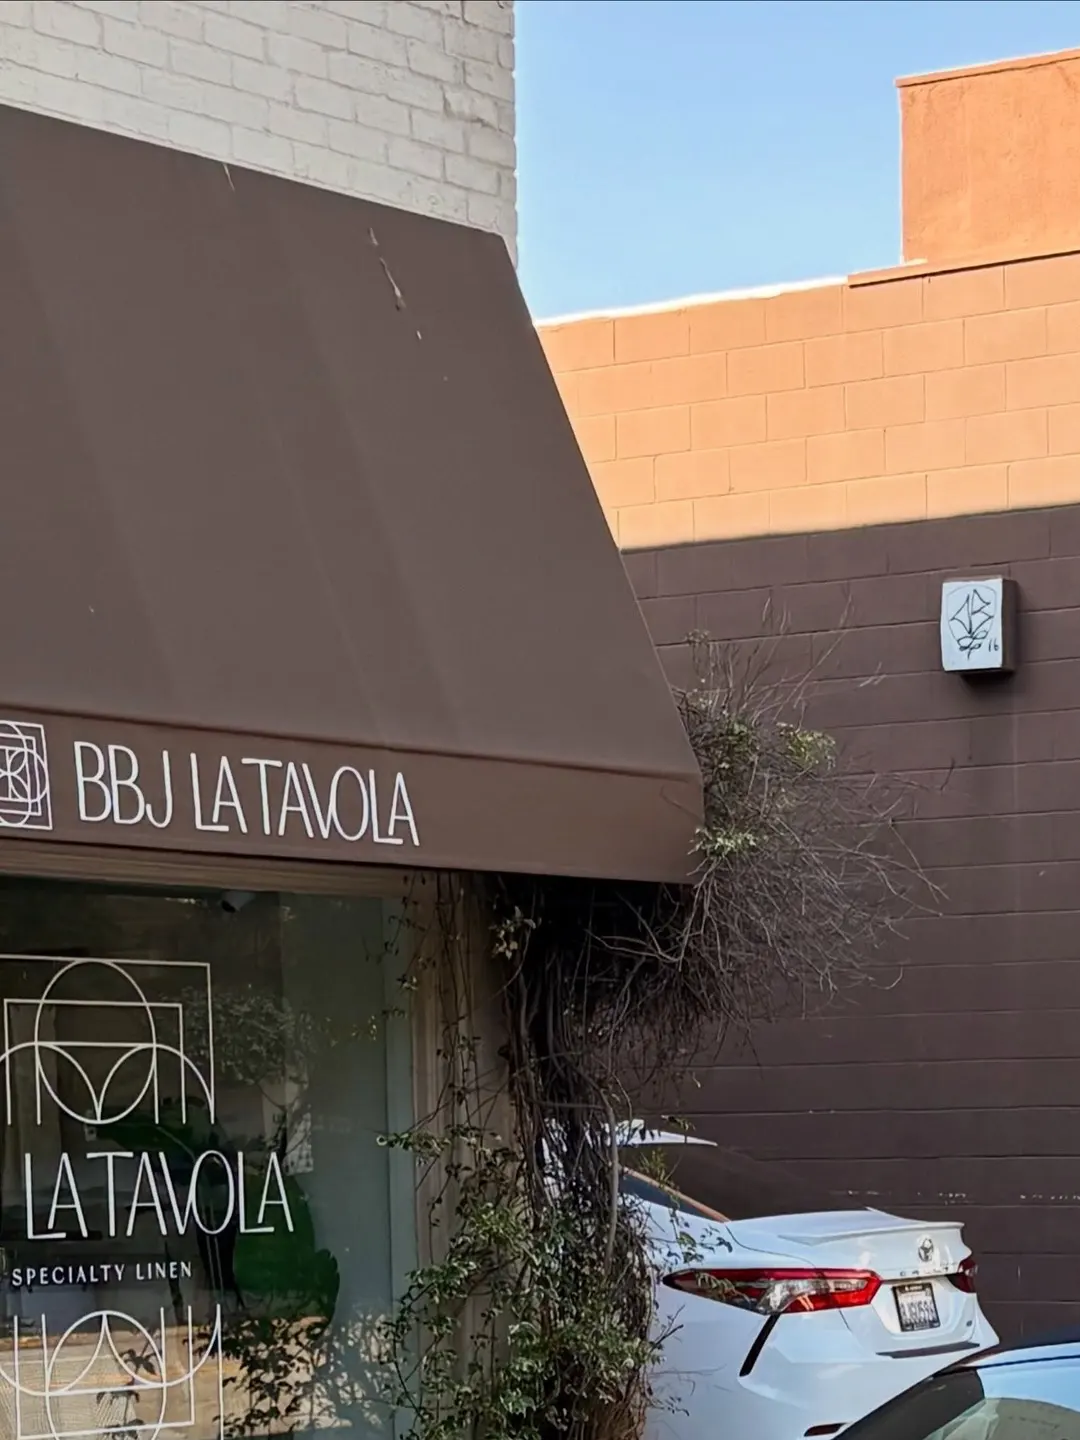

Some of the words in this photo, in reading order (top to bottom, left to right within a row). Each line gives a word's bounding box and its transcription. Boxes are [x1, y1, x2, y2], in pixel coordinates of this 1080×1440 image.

[74, 741, 174, 828] BBJ
[12, 1264, 125, 1286] SPECIALTY
[136, 1261, 192, 1281] LINEN
